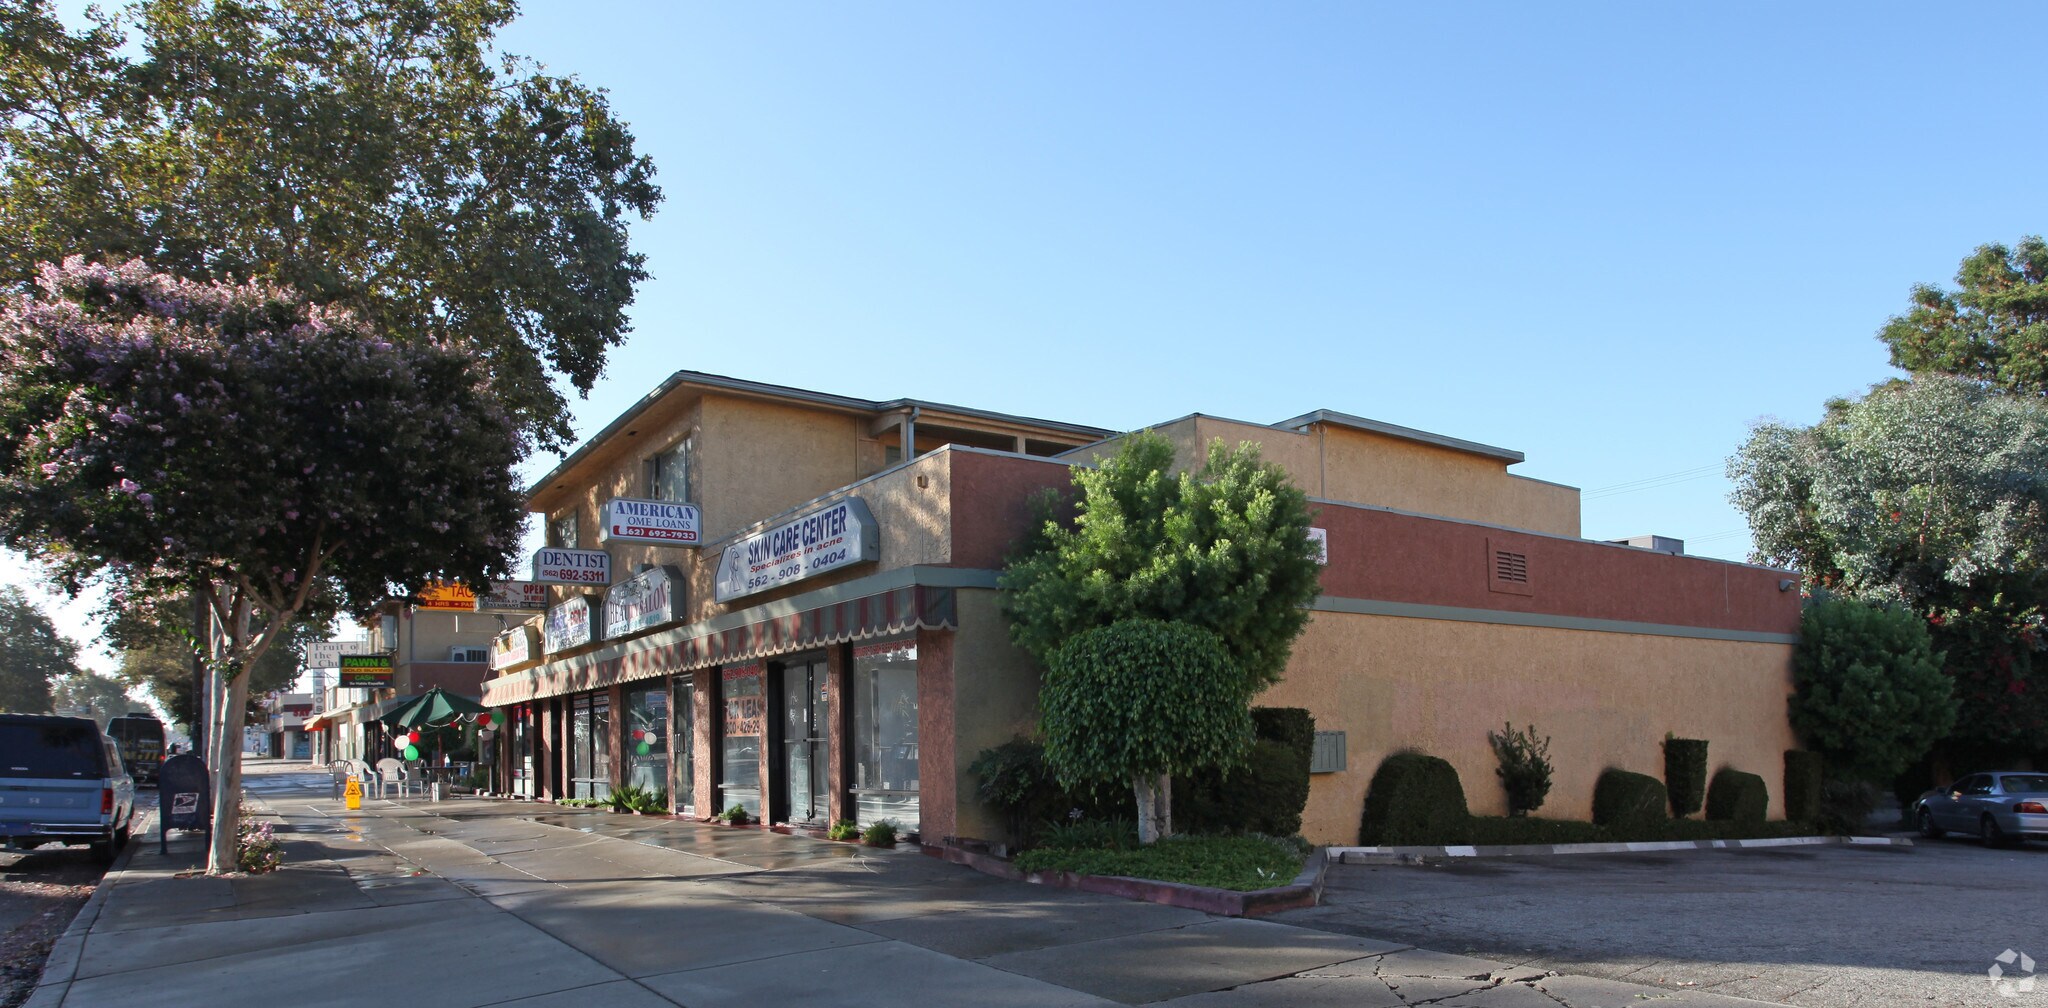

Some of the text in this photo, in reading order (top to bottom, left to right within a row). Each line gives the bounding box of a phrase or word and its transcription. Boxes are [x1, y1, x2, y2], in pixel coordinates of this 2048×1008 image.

[615, 501, 694, 520] AMERICAN
[656, 518, 691, 530] LOANS
[648, 530, 695, 540] 692-7933
[748, 505, 847, 566] SKIN CARE CENTER
[543, 551, 607, 569] DENTIST
[750, 536, 843, 573] Specializes in acne
[748, 574, 768, 589] 562
[778, 563, 801, 581] 908
[812, 548, 847, 569] 0404
[542, 569, 605, 582] (562) 692-5311
[523, 584, 545, 595] OPEN
[639, 582, 667, 616] SALON
[315, 643, 344, 651] Fruit
[314, 651, 332, 659] the
[344, 658, 389, 667] PAWN &
